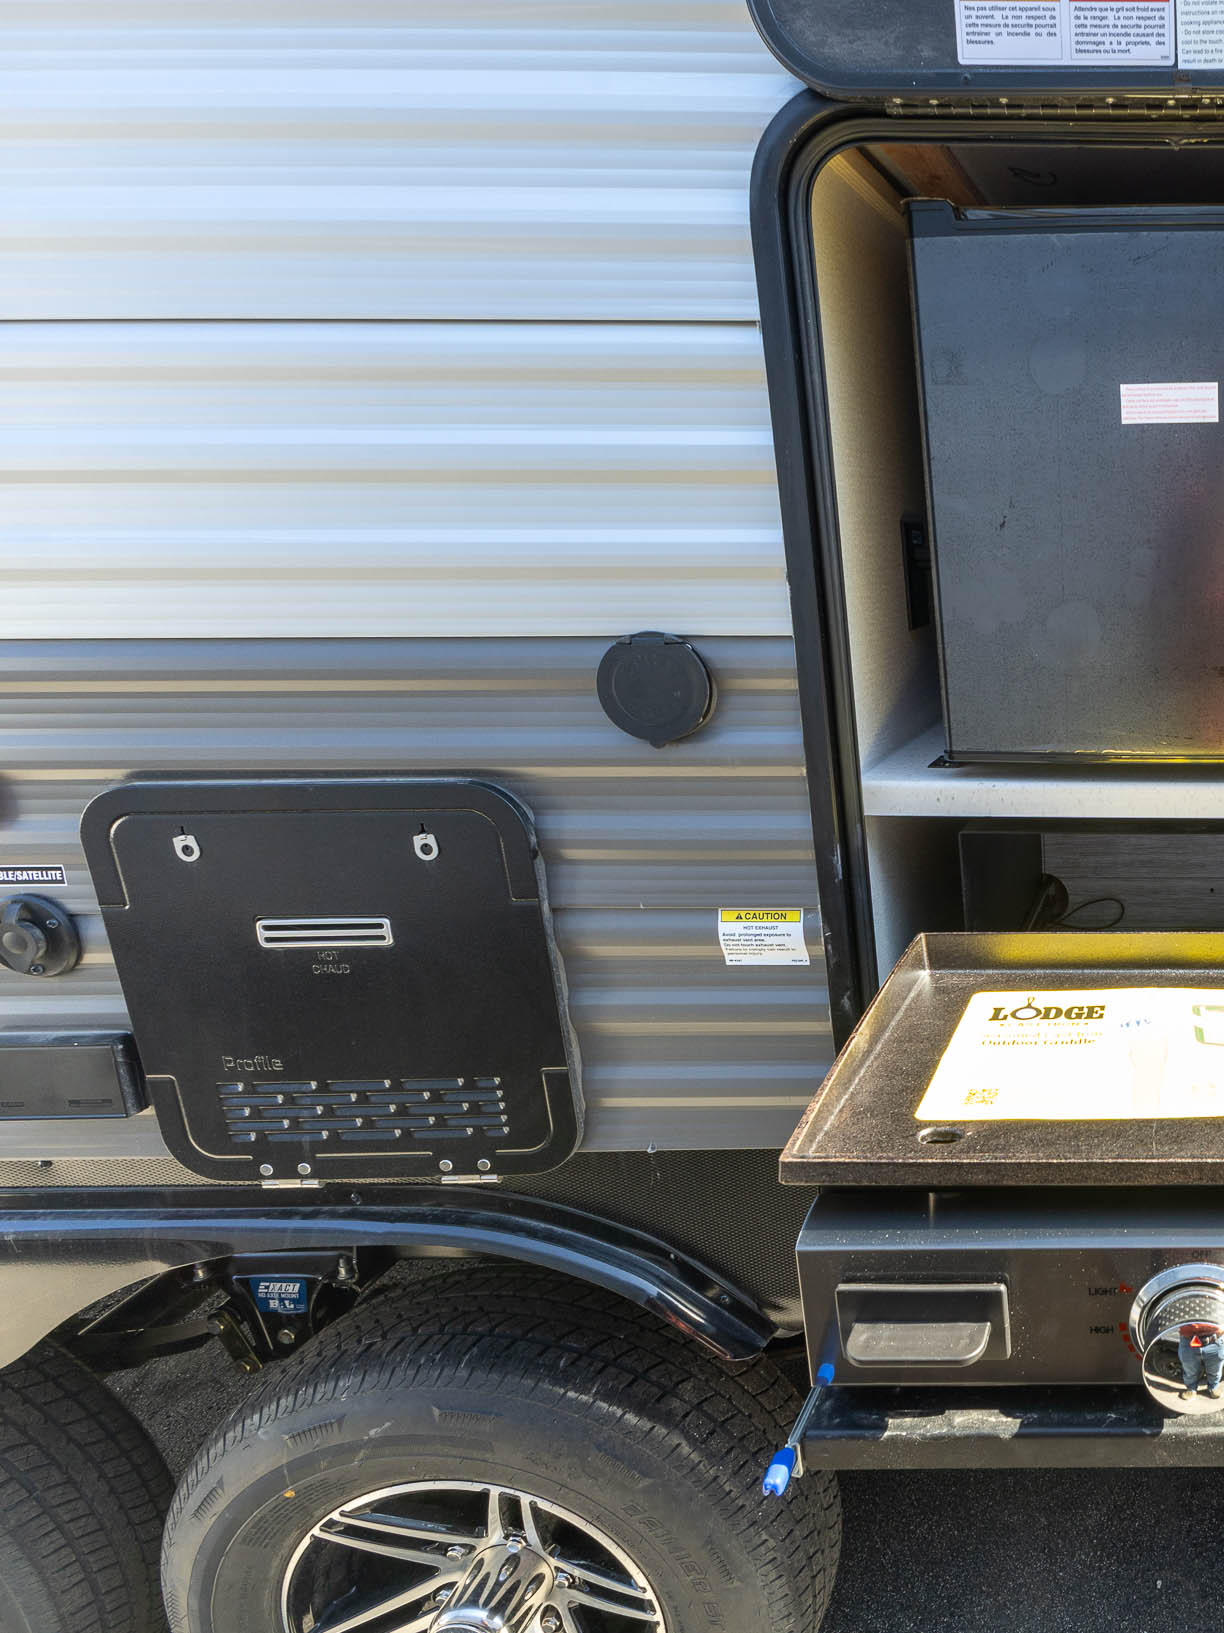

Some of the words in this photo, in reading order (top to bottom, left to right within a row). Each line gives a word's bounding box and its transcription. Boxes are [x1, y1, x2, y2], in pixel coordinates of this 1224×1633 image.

[317, 951, 339, 960] HOT
[312, 964, 350, 974] CHAUD
[988, 1000, 1106, 1022] LODGE
[222, 1056, 284, 1071] Profile
[258, 1282, 300, 1292] EXACT
[1088, 1288, 1118, 1296] LIGHT
[1089, 1326, 1114, 1334] HIGH
